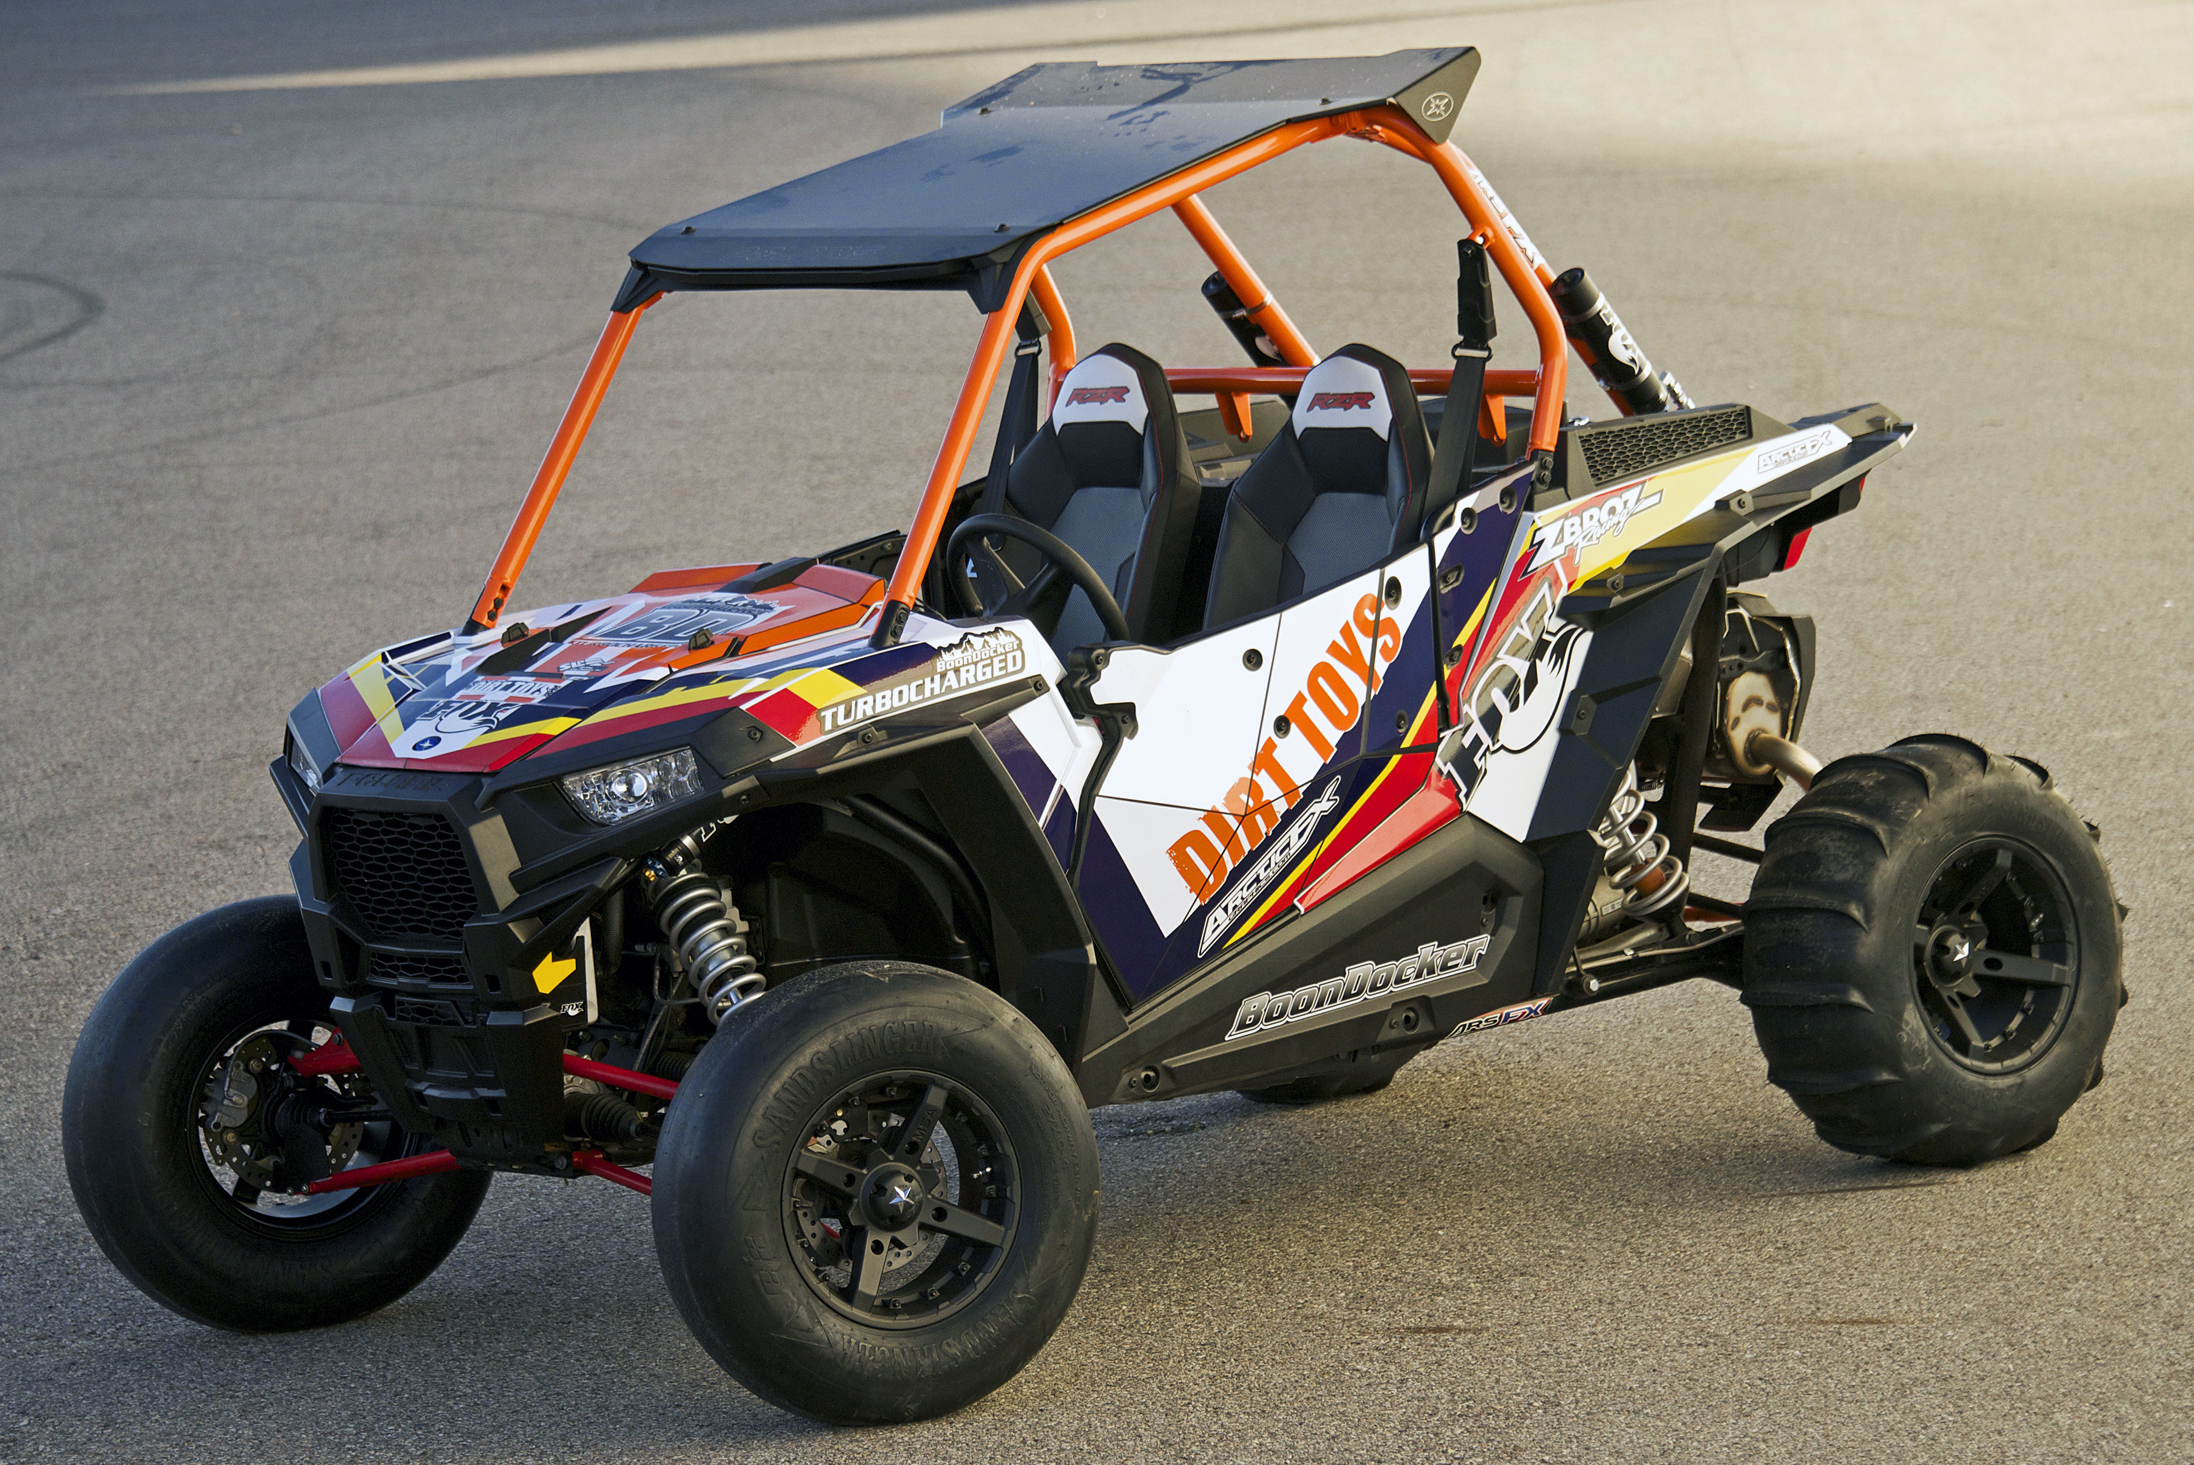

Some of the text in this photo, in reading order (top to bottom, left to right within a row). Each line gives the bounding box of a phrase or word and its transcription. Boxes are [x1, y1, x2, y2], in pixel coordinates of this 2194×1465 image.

[1065, 386, 1130, 408] RZR
[1307, 391, 1375, 412] RZR
[1573, 497, 1645, 566] Racing
[467, 680, 513, 692] DIRT
[508, 681, 551, 697] TOYS
[821, 650, 1023, 732] TURBOCHARGED
[1435, 576, 1583, 812] FOX
[416, 700, 521, 728] FOX
[1167, 736, 1303, 906] DIRT
[1283, 592, 1401, 764] TOYS
[560, 1001, 584, 1015] FOX
[1226, 935, 1490, 1040] BoonDocker
